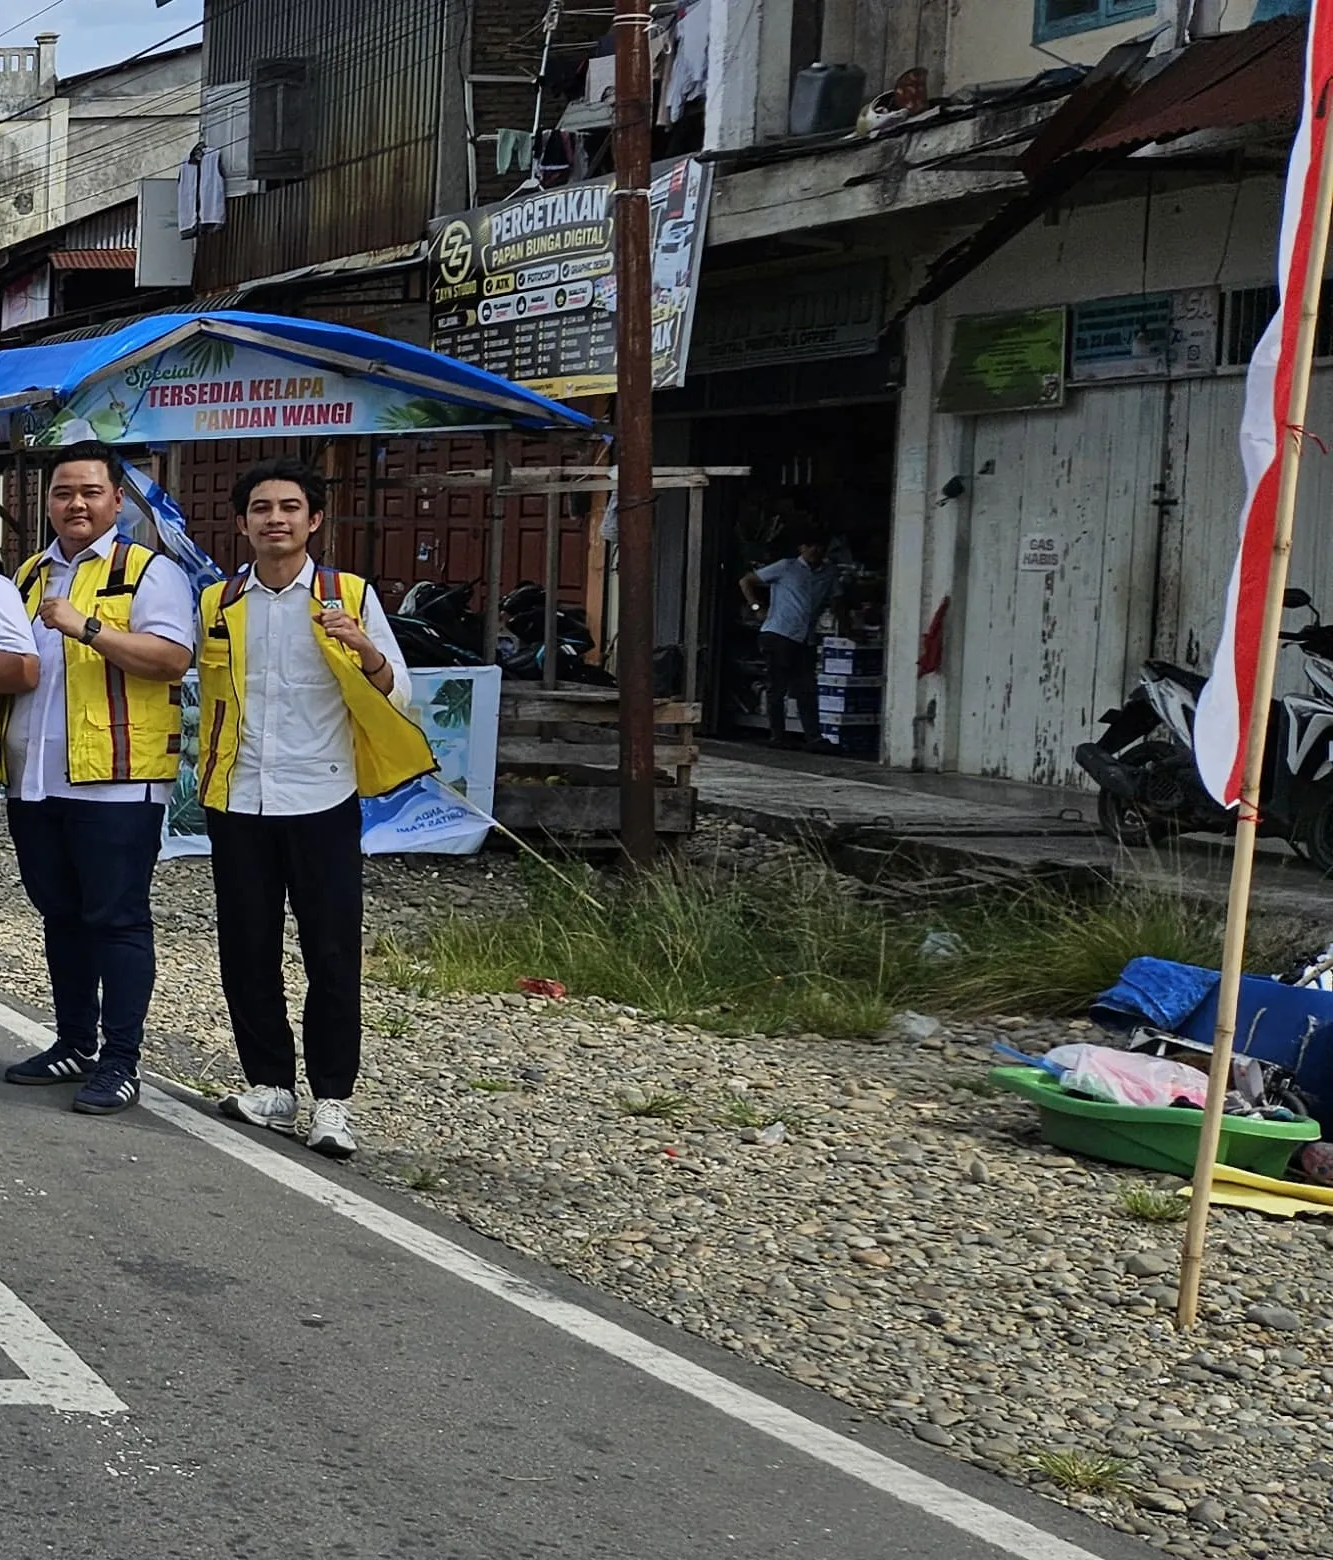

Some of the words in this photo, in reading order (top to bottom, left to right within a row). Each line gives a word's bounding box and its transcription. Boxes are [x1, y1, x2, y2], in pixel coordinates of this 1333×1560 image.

[491, 186, 607, 246] PERCETAKAN
[491, 243, 523, 267] PAPAN
[525, 234, 561, 258] BUNGA
[563, 225, 605, 249] DIGITAL
[495, 277, 510, 291] ATK
[125, 362, 195, 389] Special
[148, 380, 244, 408] TERSEDIA
[249, 376, 325, 402] KELAPA
[195, 405, 276, 432] PANDAN
[282, 402, 353, 427] WANGI
[1029, 538, 1054, 551] GAS
[1022, 552, 1059, 566] HABIS
